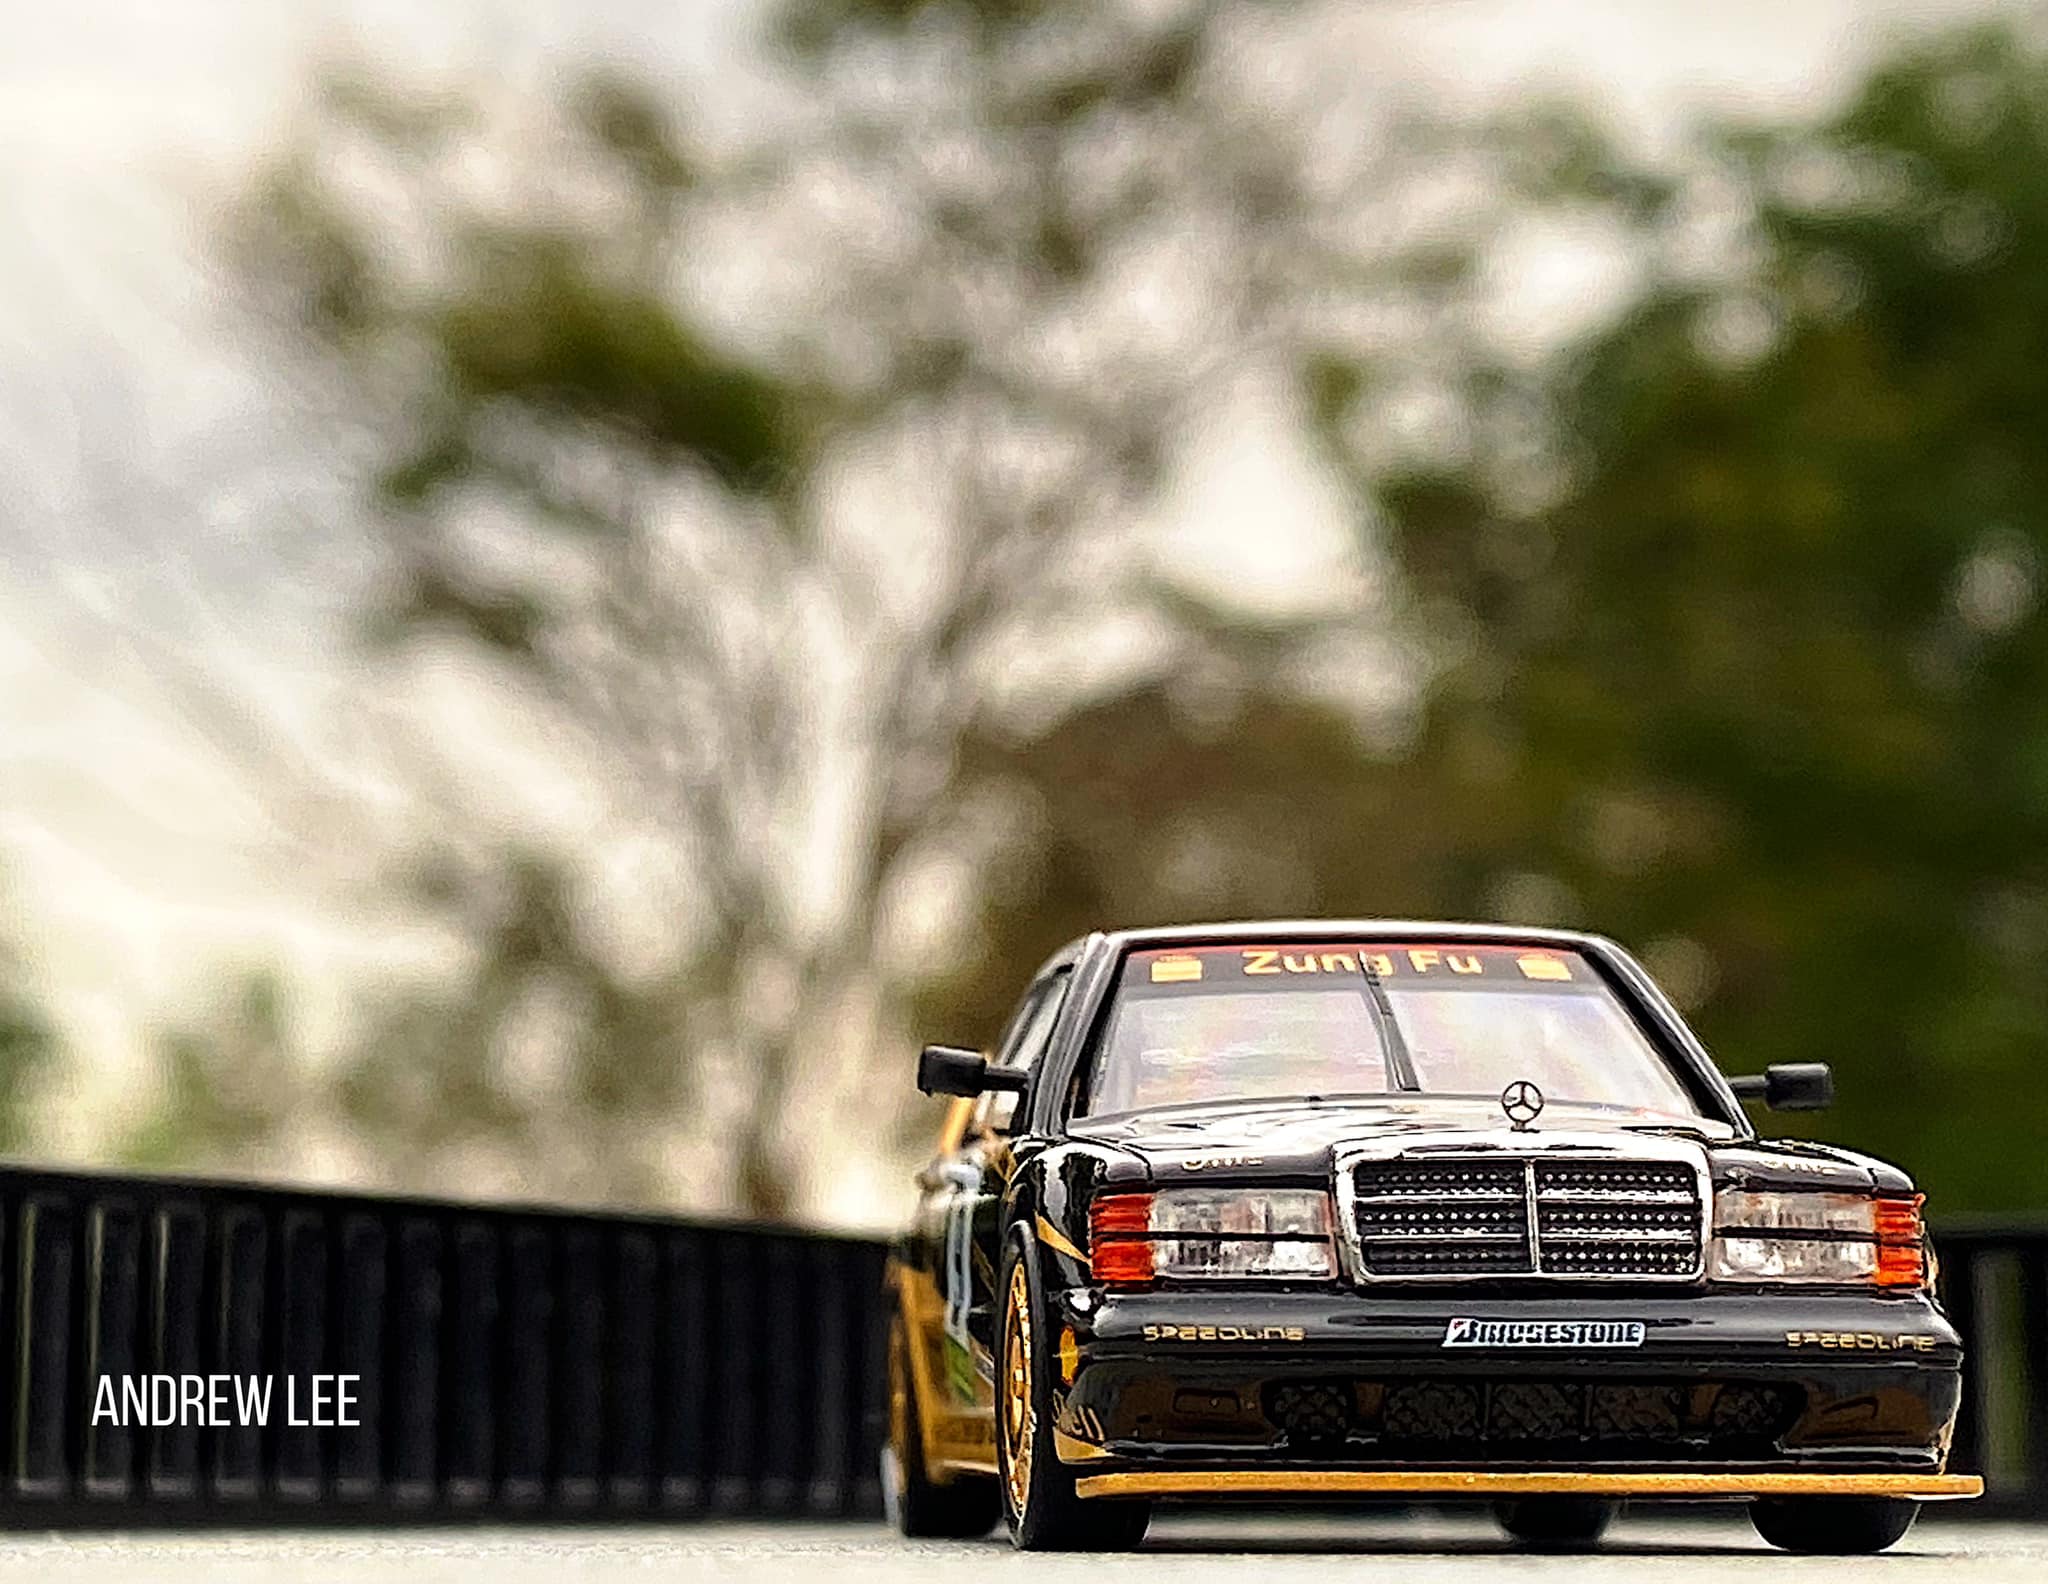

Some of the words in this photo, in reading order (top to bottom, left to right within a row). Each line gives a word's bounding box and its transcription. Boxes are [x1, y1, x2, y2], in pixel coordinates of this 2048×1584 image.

[1241, 950, 1393, 976] Zung
[1408, 950, 1483, 974] Fu
[1451, 1319, 1641, 1344] BRIDGESTONE
